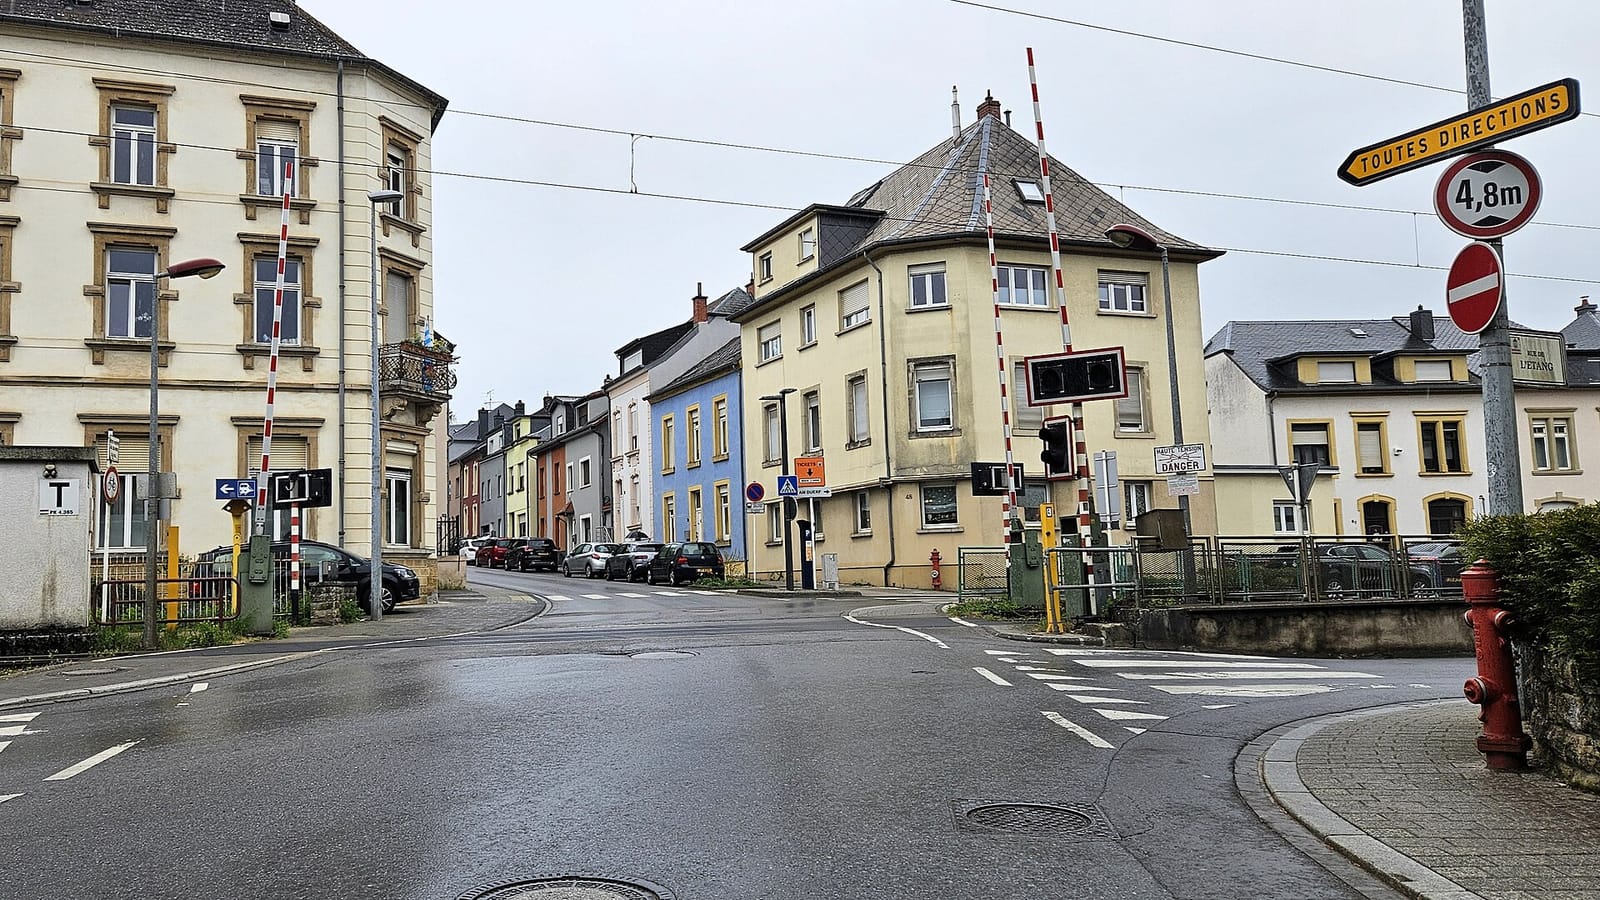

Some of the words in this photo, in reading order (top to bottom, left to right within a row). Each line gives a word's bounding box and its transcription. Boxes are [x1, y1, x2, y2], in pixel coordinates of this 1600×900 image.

[1360, 137, 1428, 173] TOUTES
[1439, 92, 1561, 147] DIRECTIONS
[1455, 179, 1522, 213] 4,8m
[1162, 462, 1199, 471] DANGER
[49, 482, 70, 507] T
